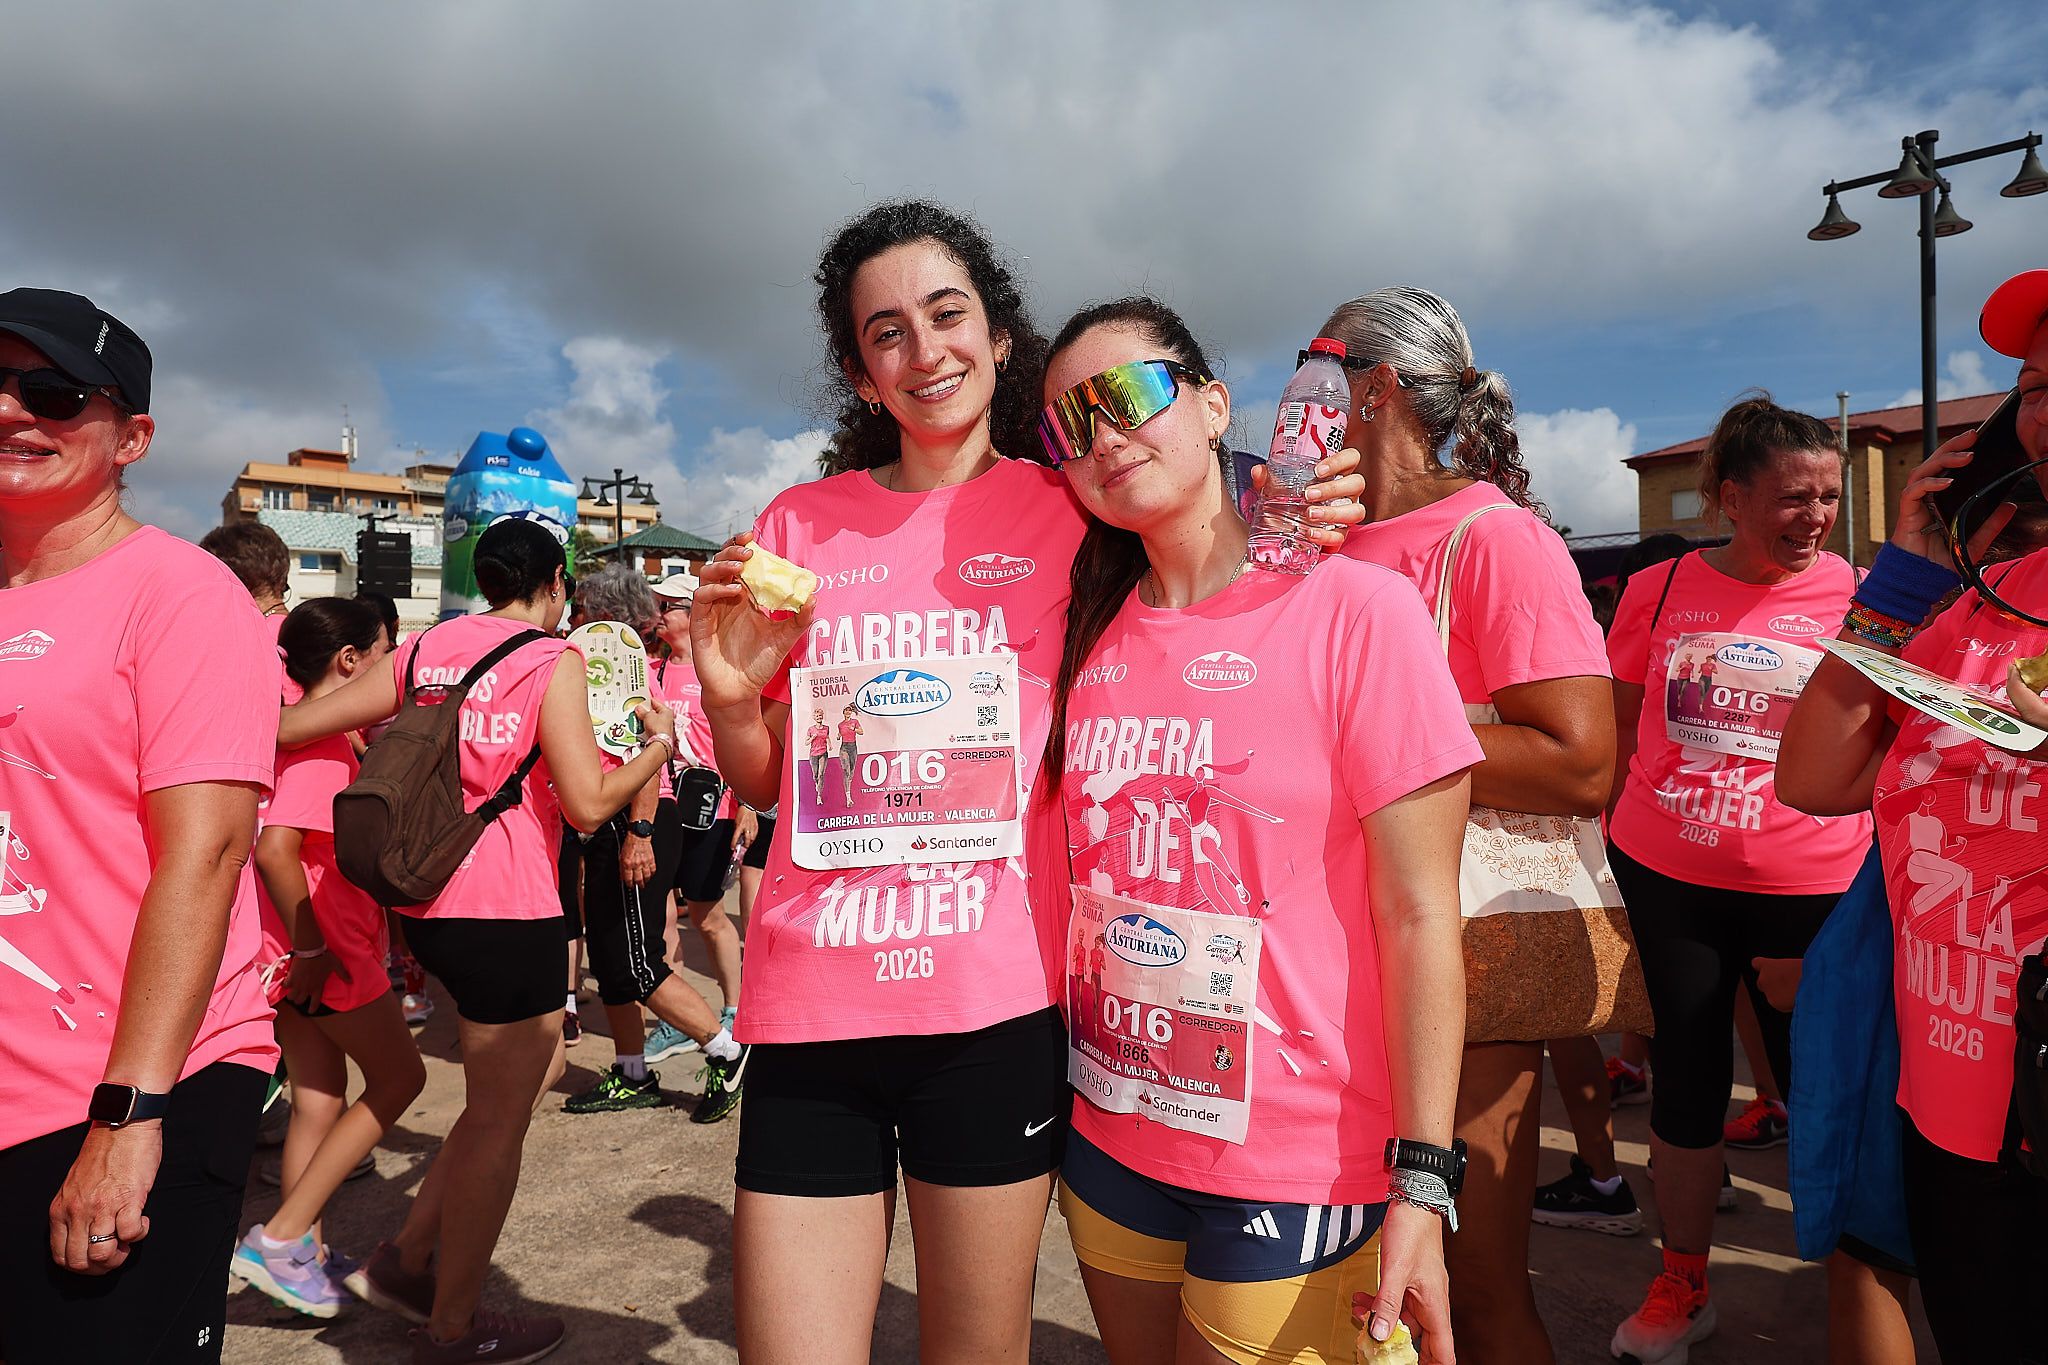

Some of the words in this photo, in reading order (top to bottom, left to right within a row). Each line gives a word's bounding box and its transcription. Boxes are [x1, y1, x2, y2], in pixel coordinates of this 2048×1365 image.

[965, 564, 1030, 580] ASTURIANA
[807, 605, 1010, 666] CARRERA
[1772, 619, 1820, 633] ASTURIANA
[1688, 641, 1716, 650] SUMA
[1721, 649, 1778, 668] ASTURIANA
[1953, 637, 2017, 658] SHO
[416, 666, 498, 703] SOMS
[809, 678, 819, 686] TU
[819, 675, 849, 685] DORSAL
[1186, 664, 1251, 682] ASTURIANA
[812, 683, 851, 698] SUMA
[862, 689, 945, 708] ASTURIANA
[1712, 686, 1770, 713] 016
[1677, 715, 1707, 727] CARRERA
[1708, 720, 1718, 728] DE
[1719, 721, 1729, 729] LA
[1730, 723, 1756, 735] MUJER
[1724, 711, 1752, 724] 2287
[1064, 716, 1214, 780] CARRERA
[1678, 728, 1719, 744] OYSHO
[861, 750, 947, 787] 016
[950, 751, 1012, 760] CORREDORA
[698, 792, 716, 828] FILA
[884, 792, 923, 808] 1971
[1655, 785, 1765, 831] MUJER
[817, 814, 861, 830] CARRERA
[863, 813, 878, 825] DE
[880, 812, 895, 824] LA
[897, 810, 935, 823] MUJER
[945, 807, 997, 821] VALENCIA
[819, 837, 884, 858] OYSHO
[929, 836, 998, 850] Santander
[1127, 796, 1190, 884] DE
[1678, 822, 1720, 848] 2026
[812, 875, 986, 948] MUJER
[1081, 905, 1104, 925] SUMA
[1954, 868, 2018, 958] LA
[1108, 925, 1179, 960] ASTURIANA
[873, 945, 935, 983] 2026
[1904, 937, 2018, 1026] MUJE
[1103, 994, 1174, 1043] 016
[1178, 1015, 1244, 1035] CORREDORA
[1927, 1014, 1985, 1061] 2026
[1116, 1041, 1149, 1064] 1866
[1079, 1039, 1104, 1061] CARRERA
[1103, 1052, 1112, 1068] DE
[1111, 1057, 1123, 1073] LA
[1124, 1063, 1159, 1082] MUJER
[1167, 1074, 1222, 1095] VALENCIA
[1079, 1063, 1113, 1098] OYSHO
[1153, 1096, 1221, 1123] Santander
